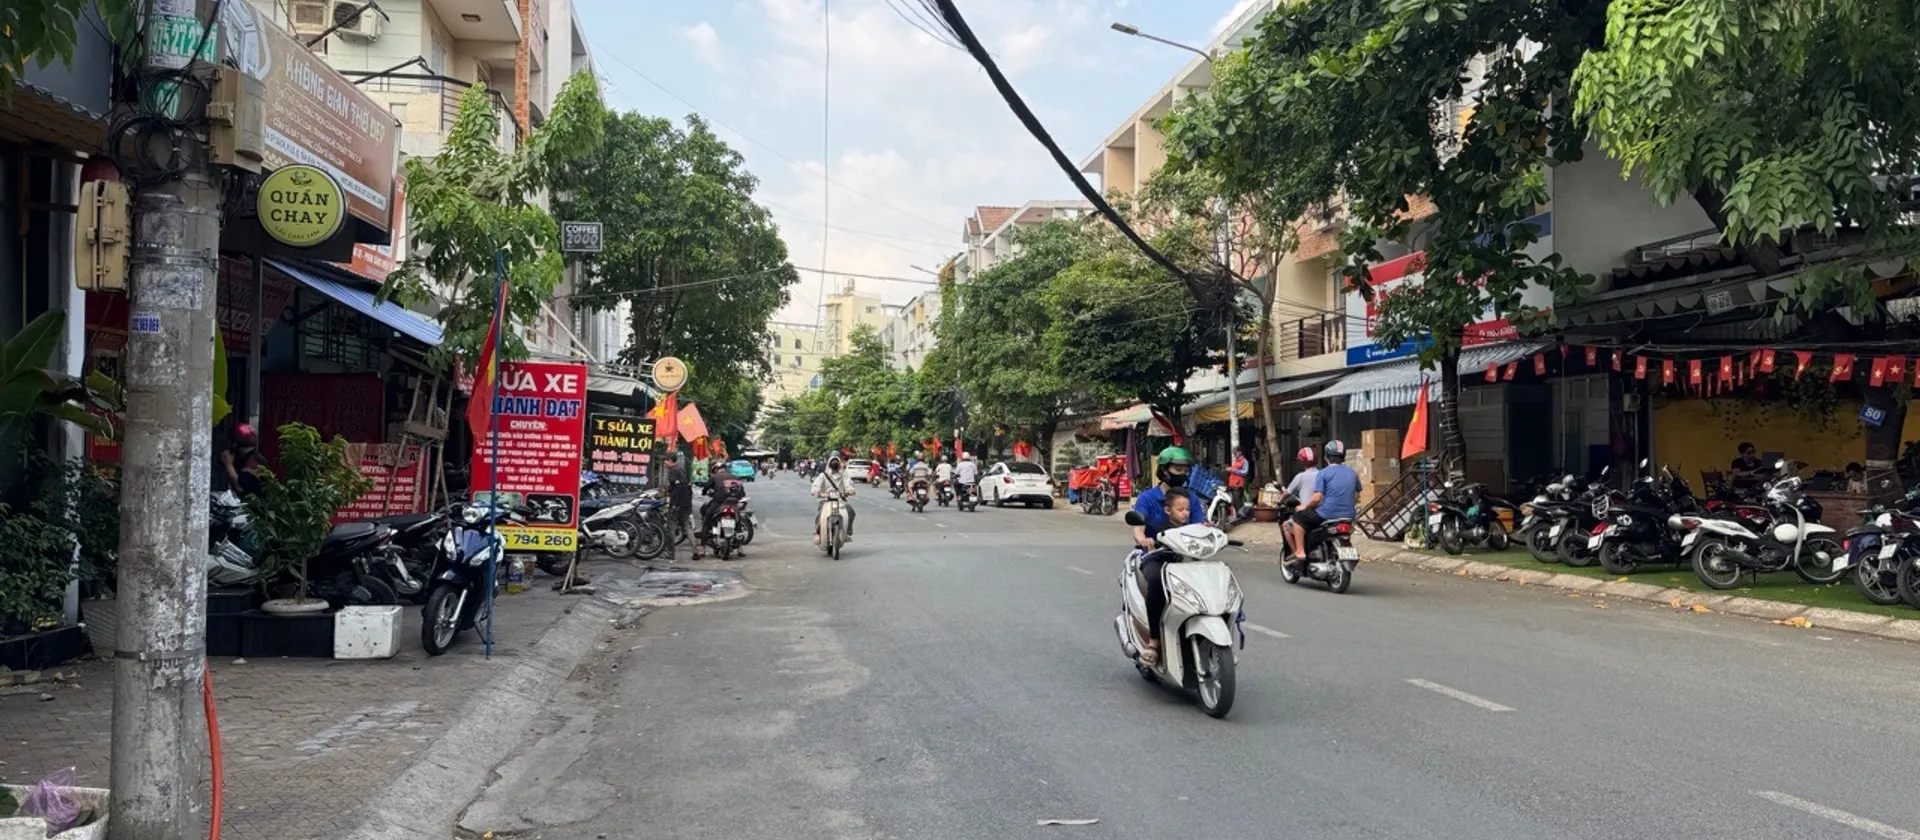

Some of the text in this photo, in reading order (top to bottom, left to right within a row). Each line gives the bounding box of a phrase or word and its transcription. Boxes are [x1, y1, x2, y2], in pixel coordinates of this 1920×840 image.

[270, 189, 329, 207] QUÁN
[271, 208, 328, 225] CHAY
[566, 225, 599, 234] COFFEE
[566, 233, 598, 244] 2000
[498, 364, 538, 392] ỬA
[543, 373, 579, 394] XE
[492, 391, 582, 421] HÀNH ĐẠT
[1865, 407, 1881, 420] 80
[608, 418, 634, 433] SỬA
[638, 424, 653, 434] XE
[593, 432, 653, 452] THÀNH LỢI
[514, 534, 540, 545] 794
[545, 536, 573, 547] 260
